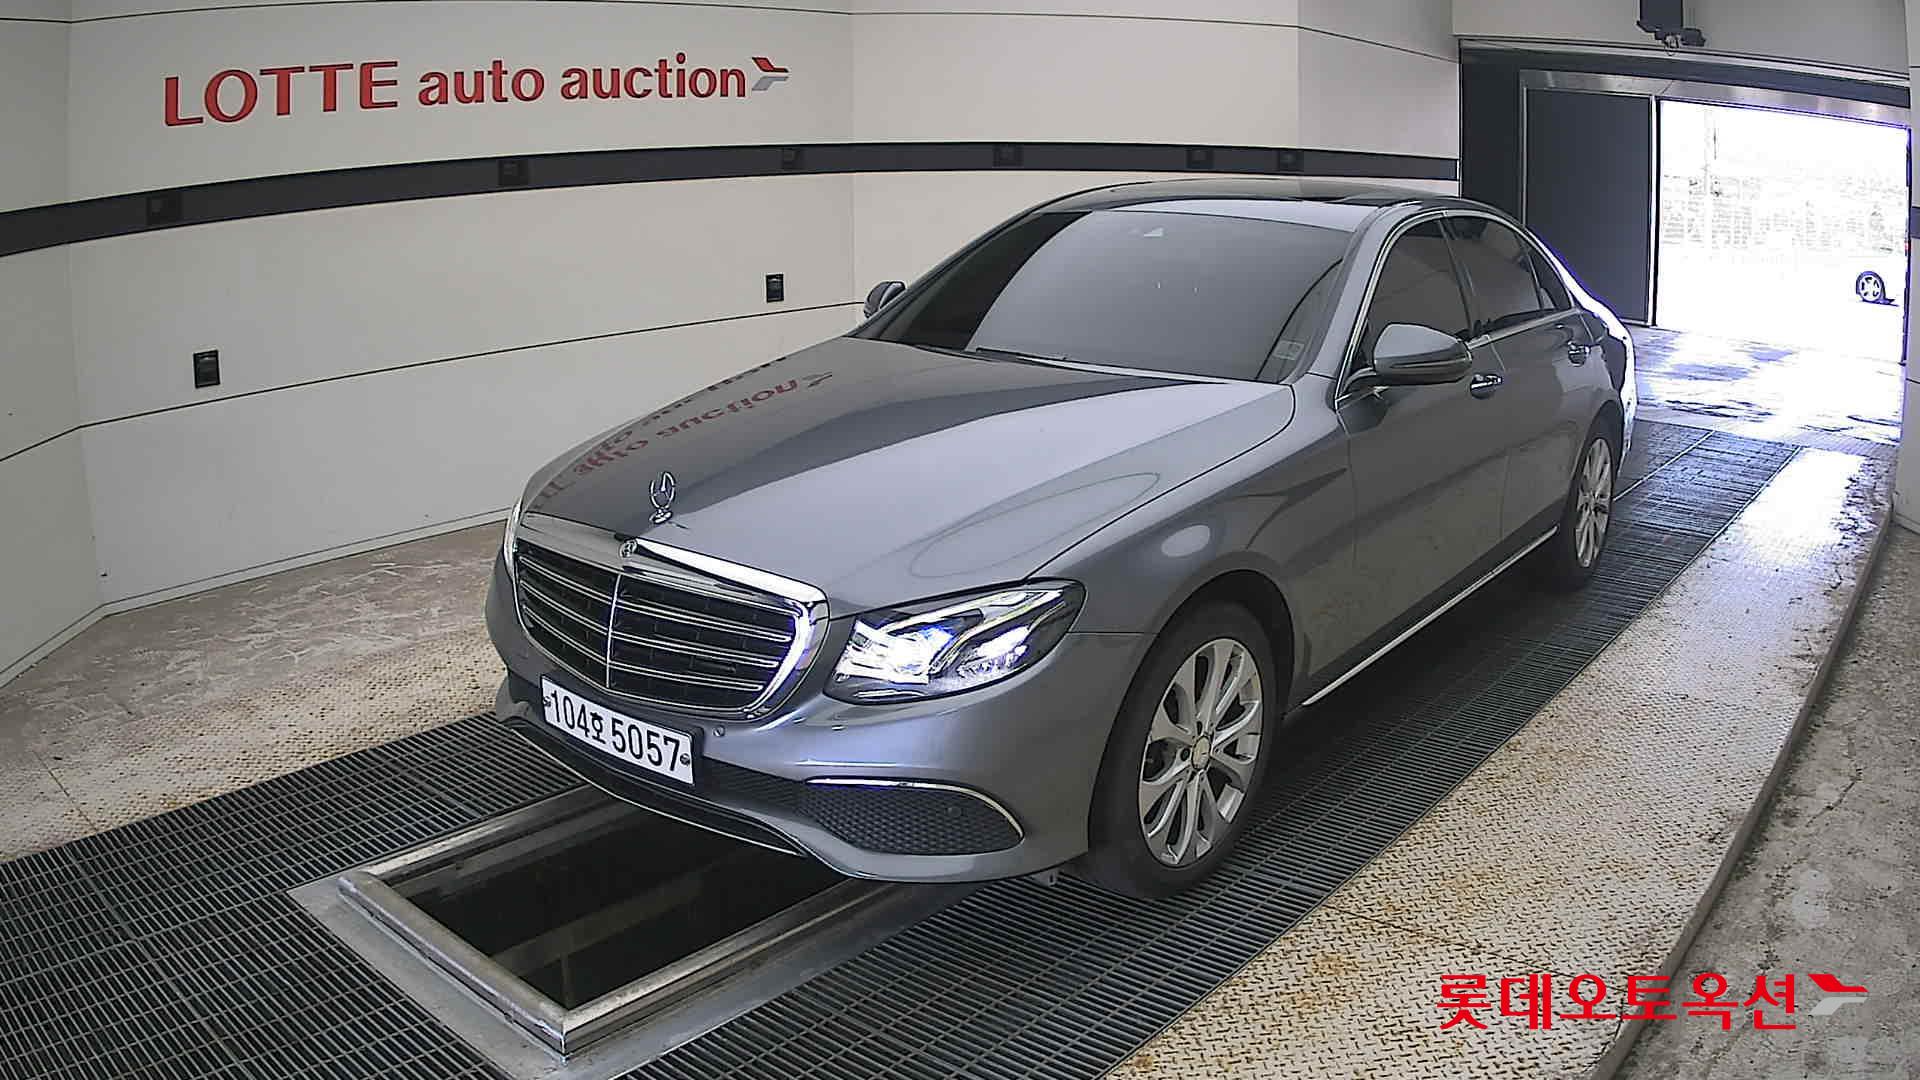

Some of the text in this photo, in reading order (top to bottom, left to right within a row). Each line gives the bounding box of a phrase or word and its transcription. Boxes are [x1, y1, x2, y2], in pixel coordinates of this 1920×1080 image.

[164, 52, 747, 127] LOTTE auto auction
[611, 717, 681, 772] 5057
